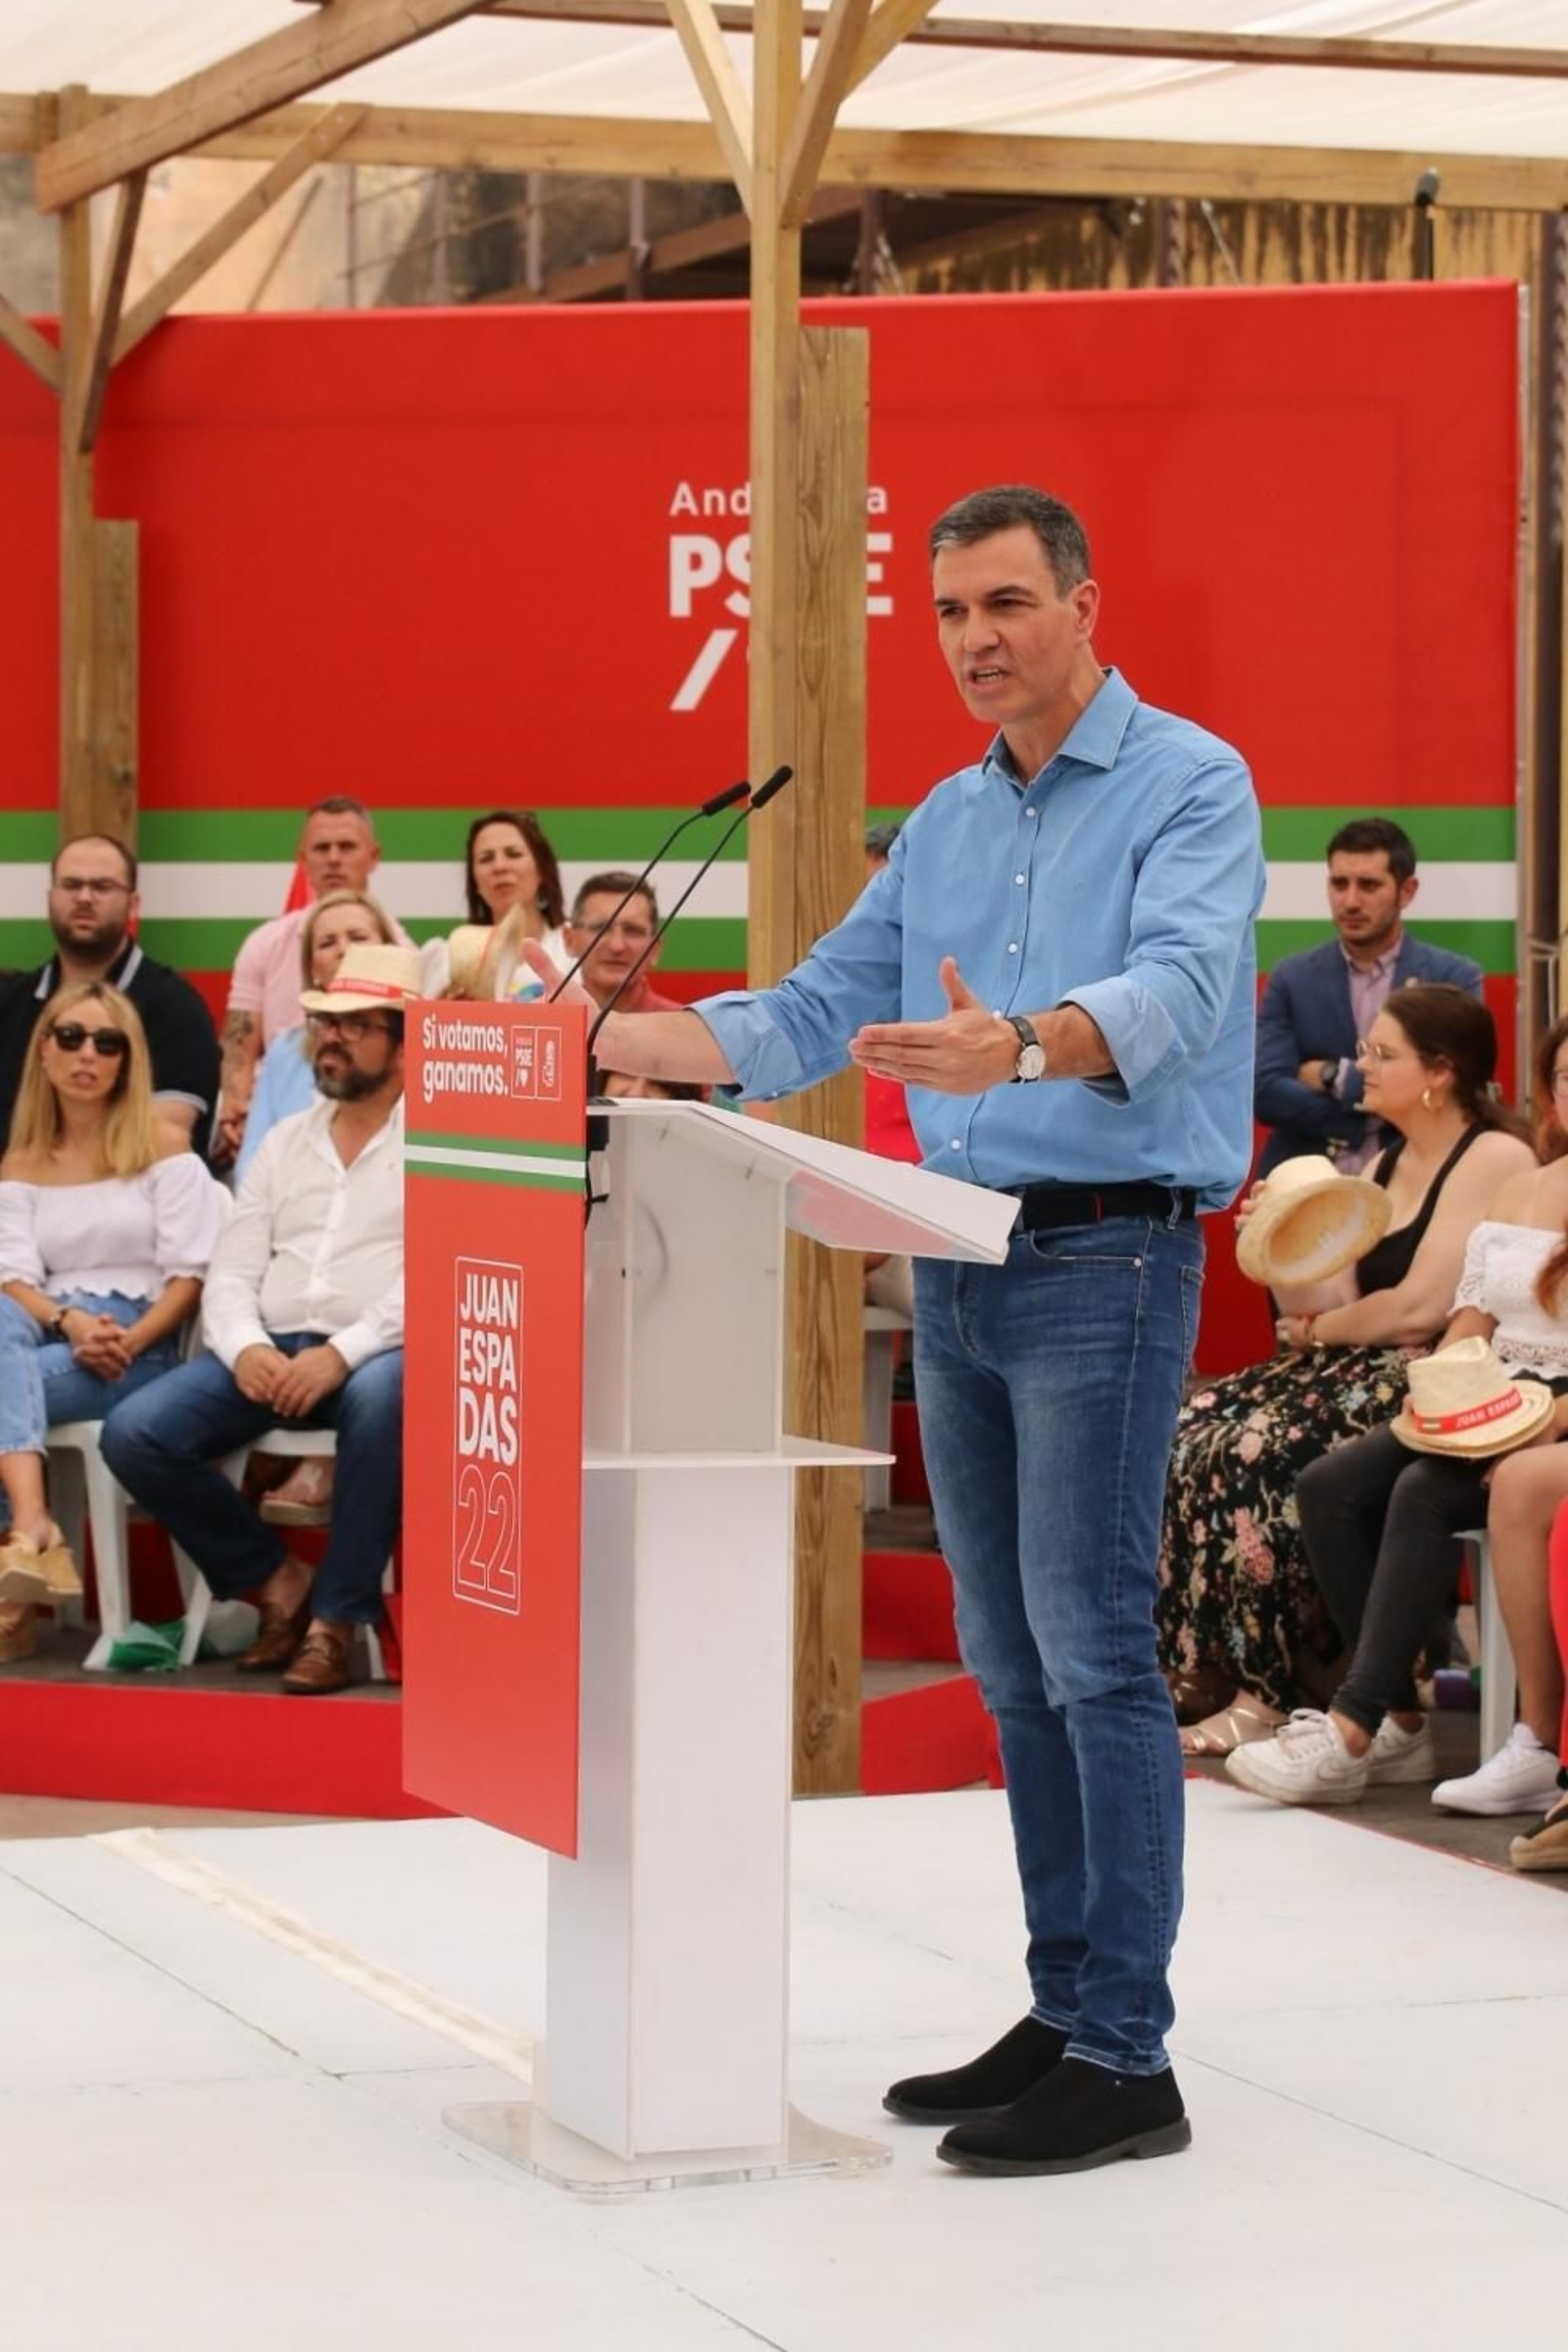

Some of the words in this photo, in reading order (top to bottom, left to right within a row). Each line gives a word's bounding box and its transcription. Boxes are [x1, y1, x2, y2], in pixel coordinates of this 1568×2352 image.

[669, 532, 893, 617] PSE
[423, 1014, 437, 1050] Si
[438, 1019, 509, 1058] votamos,
[514, 1048, 532, 1067] PSOE
[423, 1060, 509, 1103] ganamos.
[460, 1273, 518, 1330] JUAN
[460, 1328, 517, 1393] ESPA
[459, 1386, 517, 1466] DAS
[458, 1464, 515, 1598] 22
